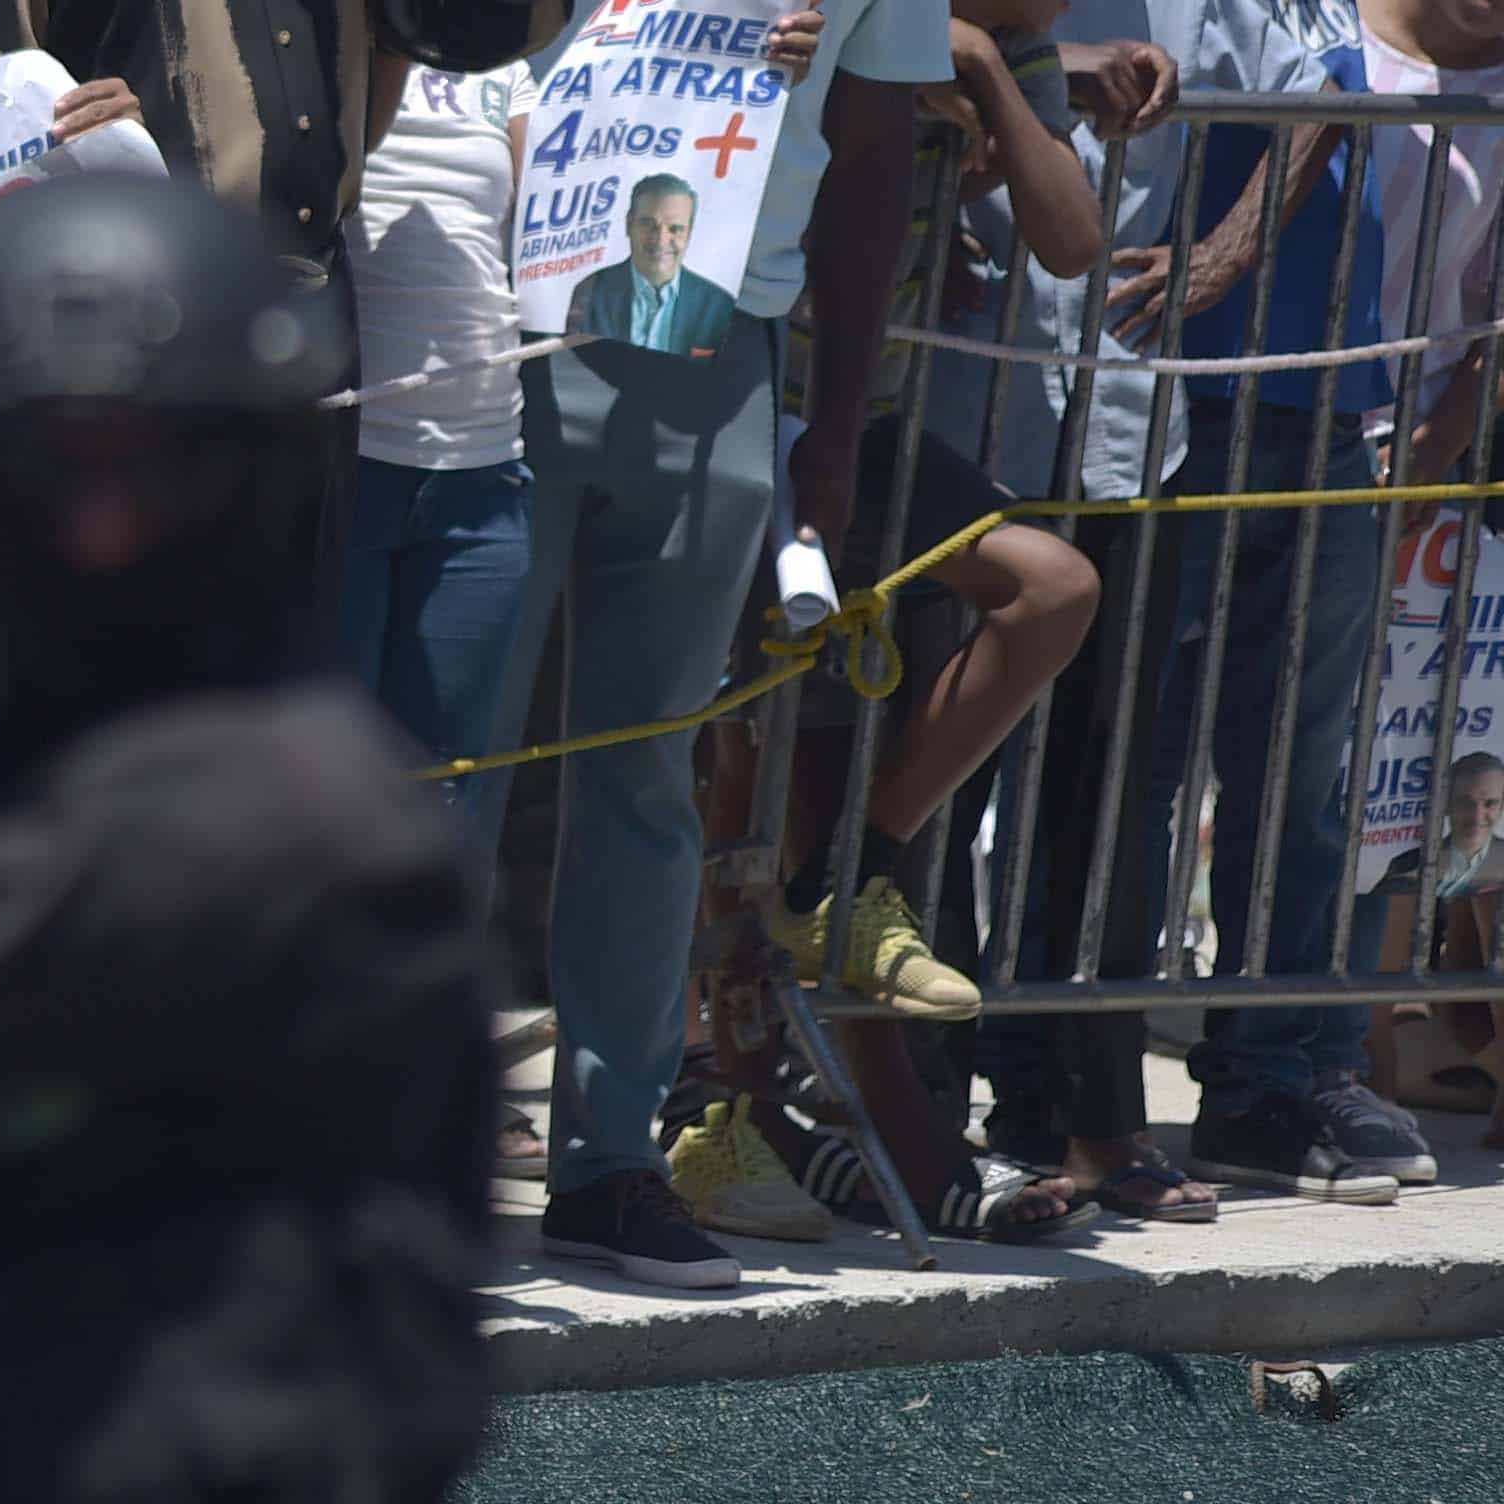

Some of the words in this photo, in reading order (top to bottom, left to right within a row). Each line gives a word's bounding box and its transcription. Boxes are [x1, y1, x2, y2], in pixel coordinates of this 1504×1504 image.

[632, 9, 772, 60] MIRE
[540, 56, 611, 107] PA'
[613, 56, 786, 108] ATRAS
[531, 109, 584, 178] 4
[579, 117, 684, 163] AÑOS
[522, 174, 621, 239] LUIS
[518, 246, 606, 284] PRESIDENTE
[519, 219, 612, 263] ABINADER
